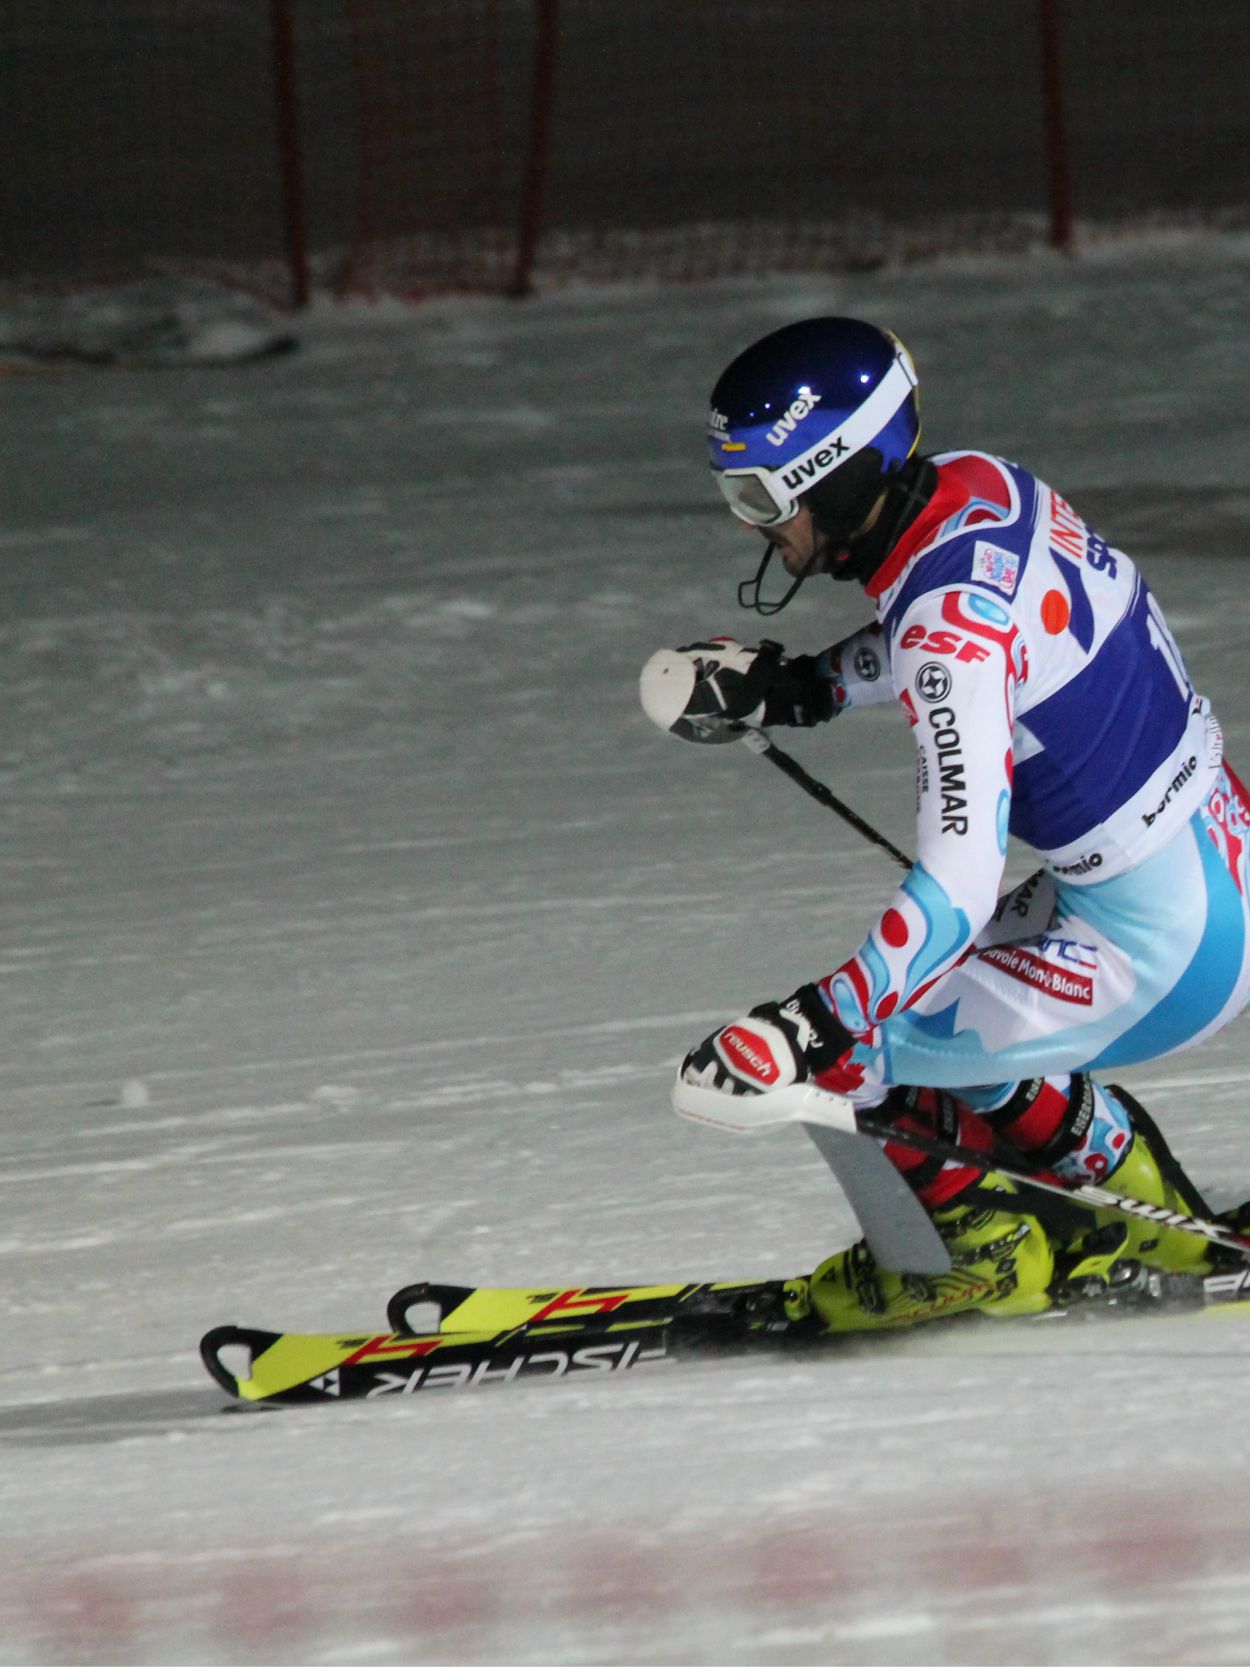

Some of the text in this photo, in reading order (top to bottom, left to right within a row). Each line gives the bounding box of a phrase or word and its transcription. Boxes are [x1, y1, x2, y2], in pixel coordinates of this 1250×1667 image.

[765, 391, 822, 446] uvex
[782, 436, 850, 490] uvex
[928, 706, 969, 836] COLMAR
[1142, 755, 1197, 828] bormio
[1051, 973, 1092, 1001] Blanc
[723, 1032, 773, 1077] reusch
[366, 1340, 676, 1399] FISCHER
